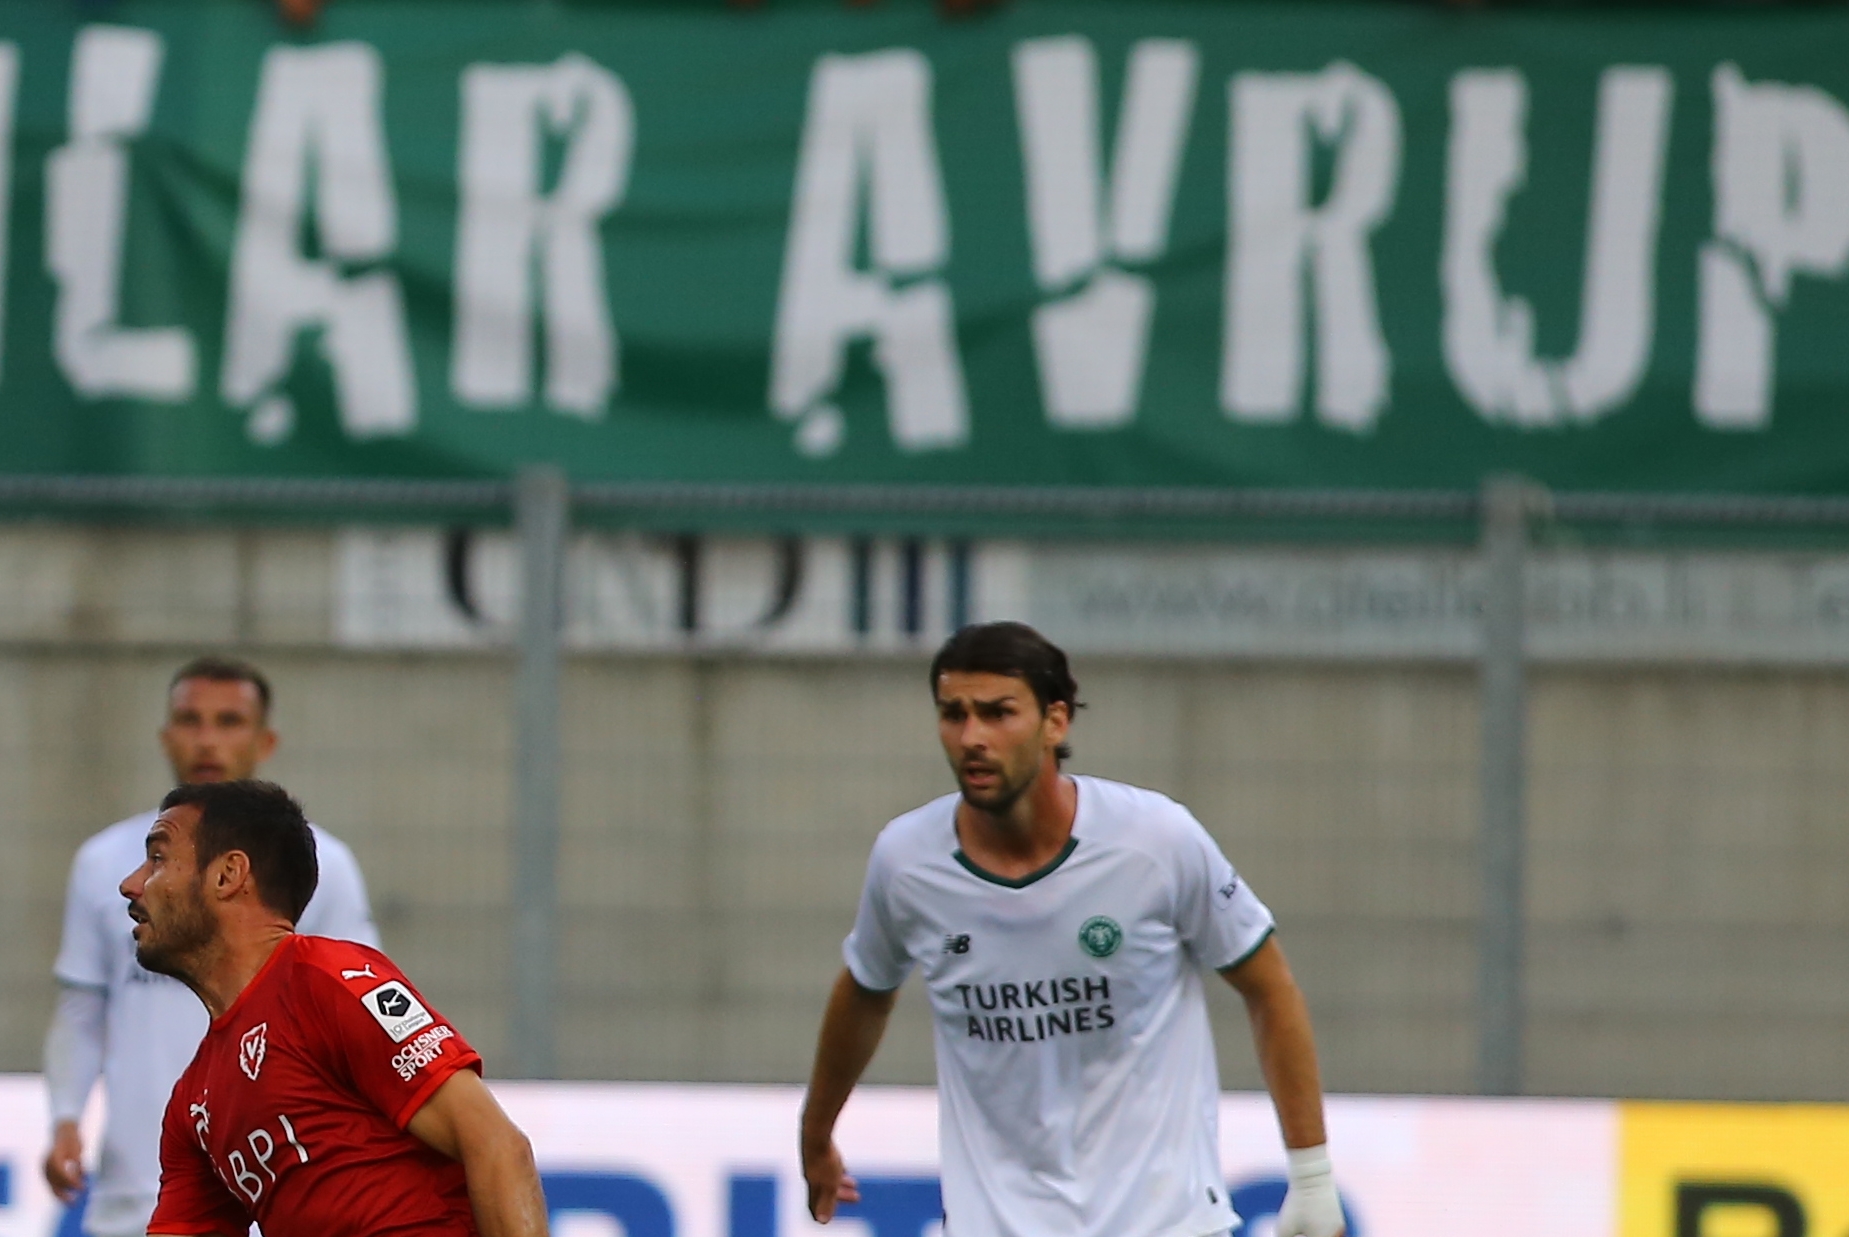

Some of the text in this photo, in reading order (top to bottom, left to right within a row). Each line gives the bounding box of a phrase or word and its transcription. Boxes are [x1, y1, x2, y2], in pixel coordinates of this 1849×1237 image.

[768, 35, 1849, 457] AVRUP
[956, 976, 1111, 1011] TURKISH
[967, 1005, 1116, 1043] AIRLINES
[392, 1026, 454, 1069] OCHSNER
[400, 1042, 443, 1082] SPORT
[224, 1114, 309, 1203] BPI
